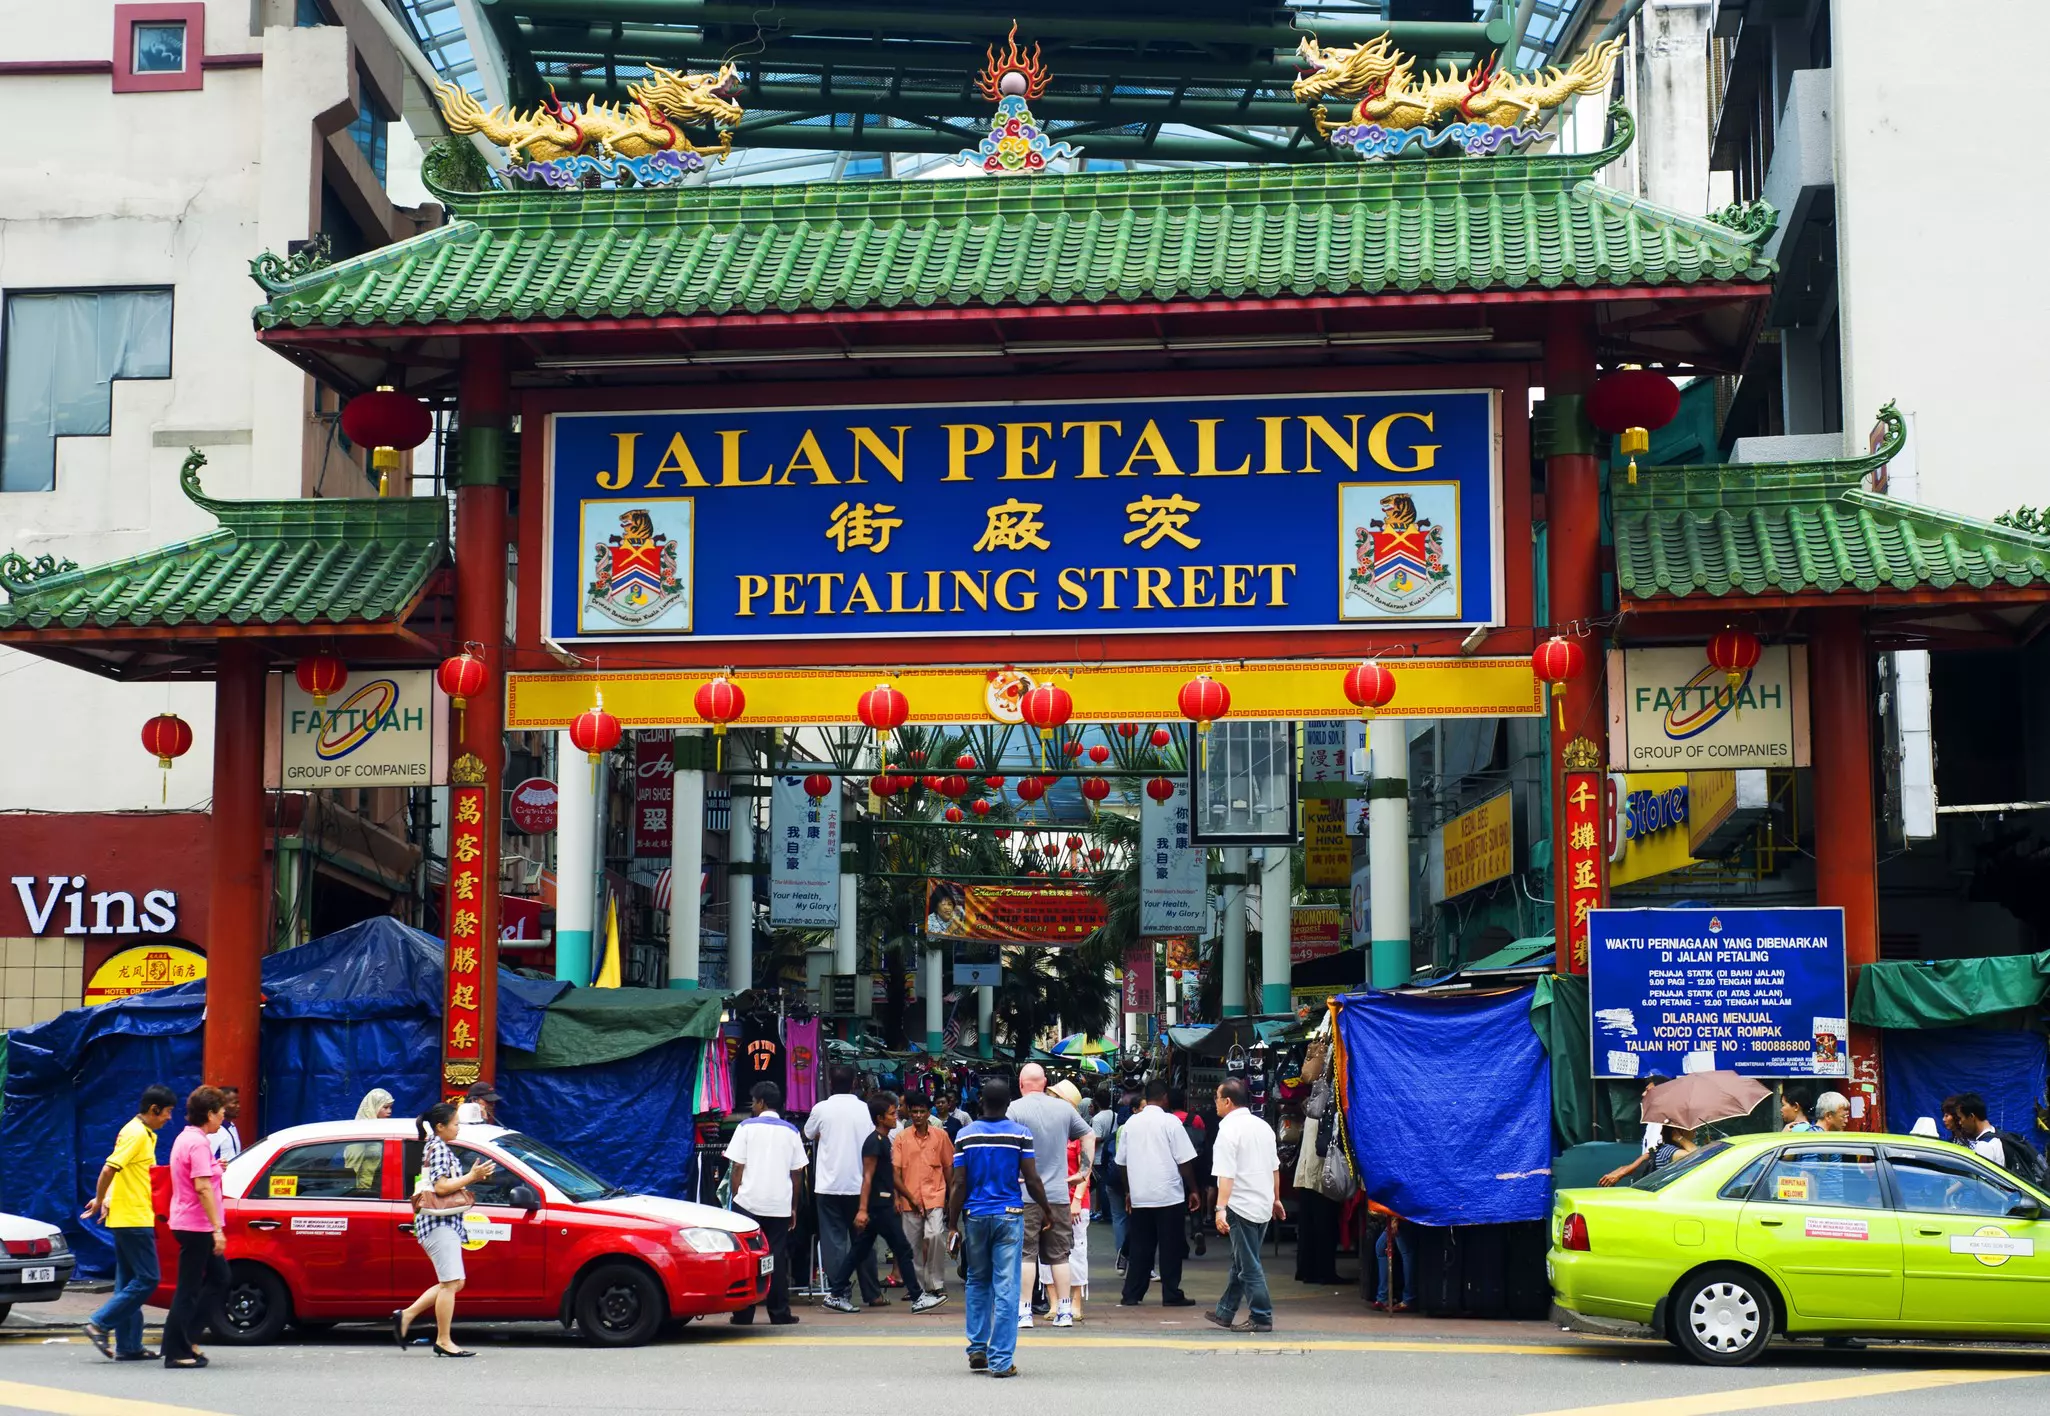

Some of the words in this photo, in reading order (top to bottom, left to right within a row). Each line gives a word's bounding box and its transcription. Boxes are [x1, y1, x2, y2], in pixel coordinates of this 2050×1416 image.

[596, 425, 913, 491] JALAN
[940, 411, 1443, 482] PETALING
[734, 567, 1040, 617] PETALING
[1058, 563, 1296, 612] STREET
[1353, 584, 1375, 599] Dewan
[1374, 596, 1409, 611] Bandaraya
[1408, 596, 1426, 608] Kuala
[1426, 580, 1448, 598] Lumpur
[1636, 684, 1782, 713] FATTUAH
[292, 706, 424, 735] FATTUAH
[1308, 731, 1327, 745] WORLD
[1633, 746, 1683, 760] GROUP
[1686, 745, 1705, 758] OF
[1708, 743, 1788, 758] COMPANIES
[287, 764, 332, 778] GROUP
[335, 763, 352, 778] OF
[354, 763, 427, 777] COMPANIES
[637, 788, 653, 801] JAPI
[653, 788, 671, 801] SHOE
[1625, 785, 1685, 842] Store
[1176, 807, 1189, 850] 你健康
[1316, 825, 1342, 833] NAM
[1316, 836, 1343, 845] HING
[786, 826, 800, 871] 我自豪
[1157, 837, 1169, 880] 我自豪
[772, 892, 791, 900] Your
[793, 892, 822, 901] Health,
[973, 888, 1003, 897] Selamat
[1005, 889, 1034, 899] Datang
[10, 875, 179, 936] Vins
[796, 903, 808, 911] My
[809, 902, 832, 912] Glory
[1144, 900, 1160, 908] Your
[1162, 900, 1190, 909] Health,
[1166, 910, 1177, 918] My
[1178, 910, 1200, 919] Glory
[1293, 909, 1340, 925] PROMOTION
[772, 917, 838, 927] www.zhen-ao.com.my
[1144, 924, 1206, 933] www.zhen-ao.com.my
[1605, 938, 1645, 950] WAKTU
[1648, 938, 1718, 950] PERNIAGAAN
[1722, 938, 1752, 950] YANG
[1756, 938, 1828, 950] DIBENARKAN
[1661, 951, 1673, 963] DI
[1677, 951, 1713, 963] JALAN
[1717, 951, 1769, 963] PETALING
[1649, 970, 1684, 978] PENJAJA
[1687, 970, 1713, 978] STATIK
[1717, 970, 1728, 978] (DI
[1731, 970, 1753, 978] BAHU
[1756, 970, 1785, 978] JALAN)
[1649, 978, 1665, 986] 9.00
[1668, 978, 1685, 986] PAGI
[1696, 978, 1715, 986] 12.00
[1719, 978, 1751, 986] TENGAH
[1754, 978, 1785, 986] MALAM
[104, 988, 129, 996] HOTEL
[1649, 990, 1684, 998] PENJAJA
[1687, 990, 1713, 998] STATIK
[1717, 990, 1728, 998] (DI
[1731, 990, 1750, 998] ATAS
[1754, 990, 1783, 998] JALAN)
[1642, 999, 1657, 1007] 6.00
[1660, 999, 1692, 1007] PETANG
[1704, 999, 1723, 1007] 12.00
[1726, 999, 1759, 1007] TENGAH
[1762, 999, 1792, 1007] MALAM
[1662, 1012, 1719, 1024] DILARANG
[1723, 1012, 1773, 1024] MENJUAL
[1653, 1026, 1693, 1038] VCD/CD
[1697, 1026, 1733, 1038] CETAK
[1737, 1026, 1782, 1038] ROMPAK
[747, 1040, 760, 1056] NEW
[761, 1040, 776, 1055] YORK
[1625, 1041, 1664, 1052] TALIAN
[1667, 1041, 1690, 1052] HOT
[1693, 1041, 1718, 1052] LINE
[1722, 1041, 1738, 1052] NO
[1750, 1040, 1811, 1052] 1800886800
[753, 1053, 771, 1071] 17
[1783, 1190, 1804, 1198] WELCOME
